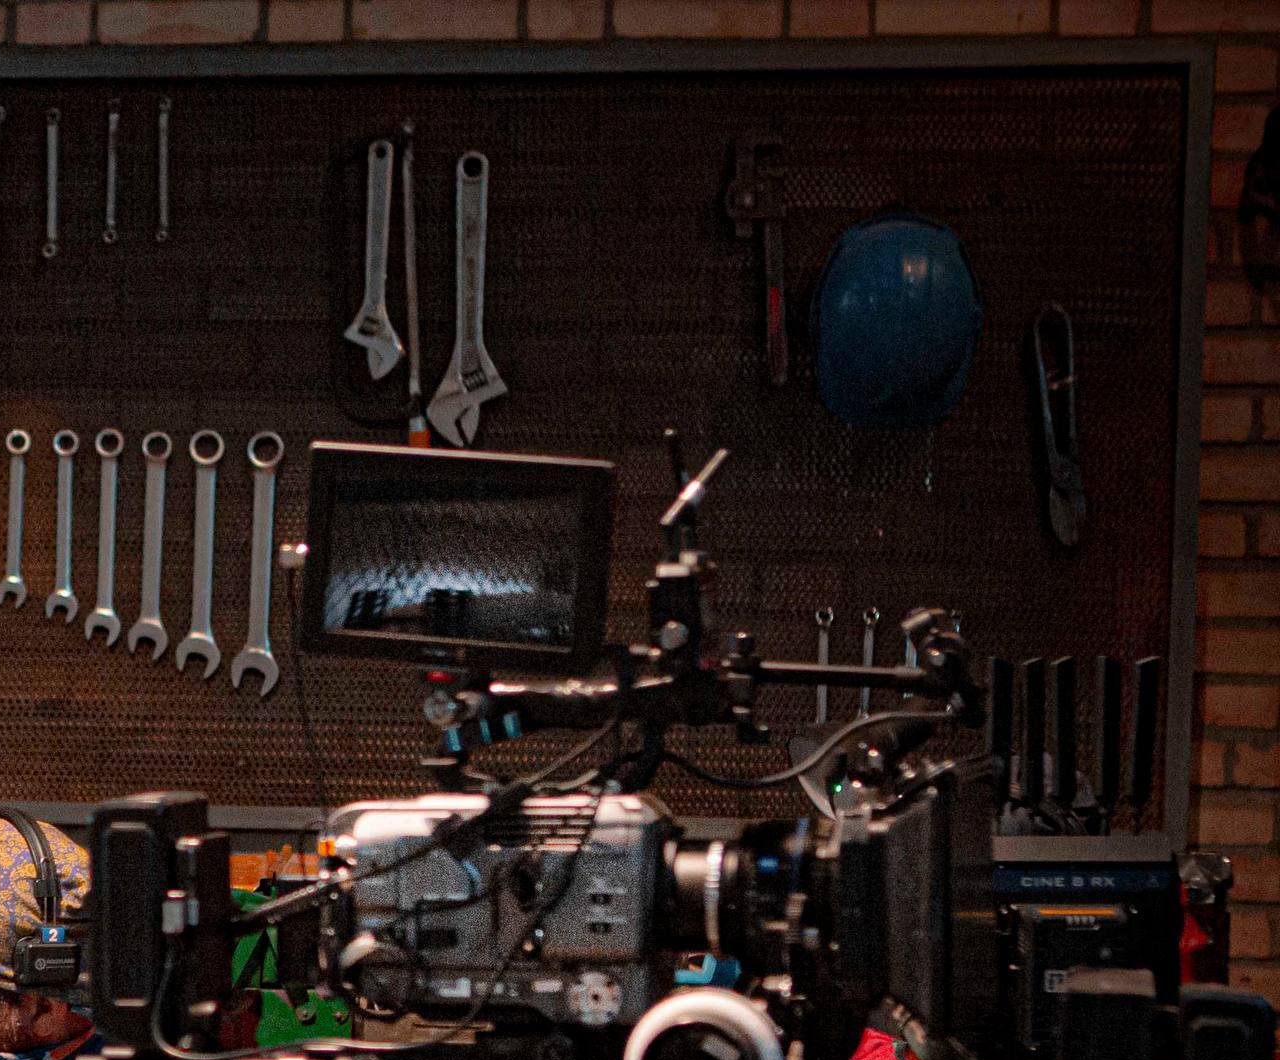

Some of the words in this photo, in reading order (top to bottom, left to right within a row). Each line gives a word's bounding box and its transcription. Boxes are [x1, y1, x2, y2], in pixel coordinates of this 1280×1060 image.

[1021, 876, 1065, 888] CINE
[1090, 876, 1116, 888] RX
[49, 927, 58, 942] 2
